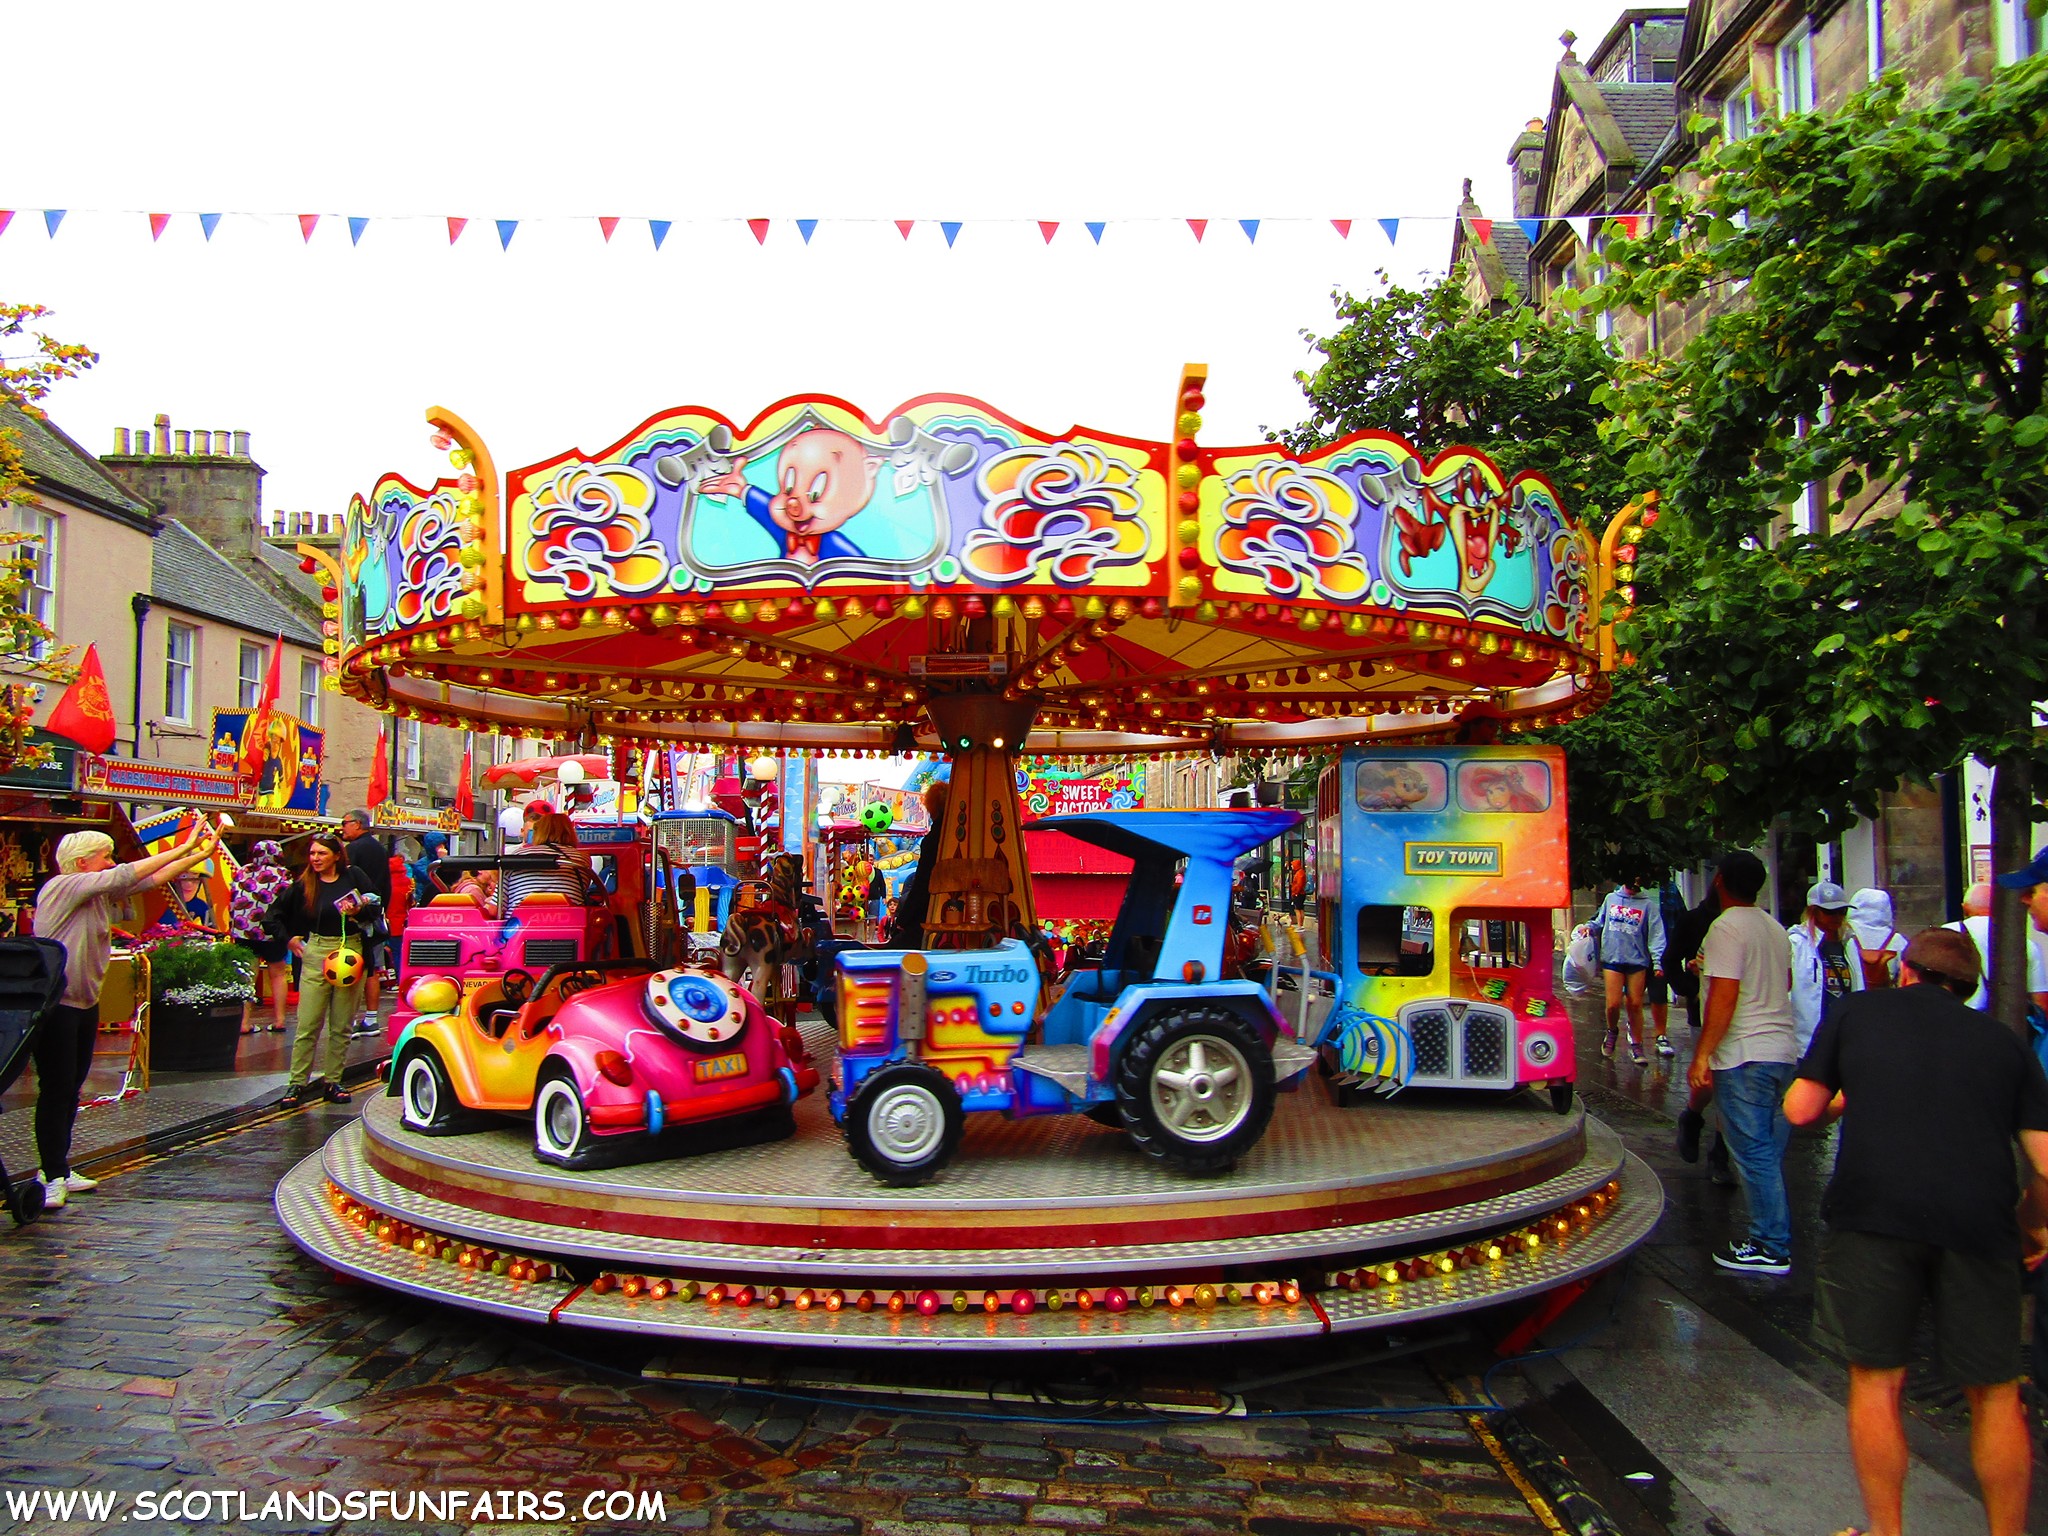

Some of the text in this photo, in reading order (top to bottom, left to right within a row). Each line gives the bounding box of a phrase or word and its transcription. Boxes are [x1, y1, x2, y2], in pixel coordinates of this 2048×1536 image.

[109, 768, 235, 796] MARSHALLS FIRE TRAINING
[1062, 785, 1101, 800] SWEET
[1055, 801, 1108, 814] FACTORY
[1417, 851, 1494, 865] TOY TOWN
[422, 912, 464, 924] 4WD
[530, 912, 571, 923] 4WD
[965, 964, 1029, 984] Turbo
[463, 980, 491, 989] NEVAD
[1525, 997, 1547, 1017] BUS
[697, 1056, 743, 1078] TAXI
